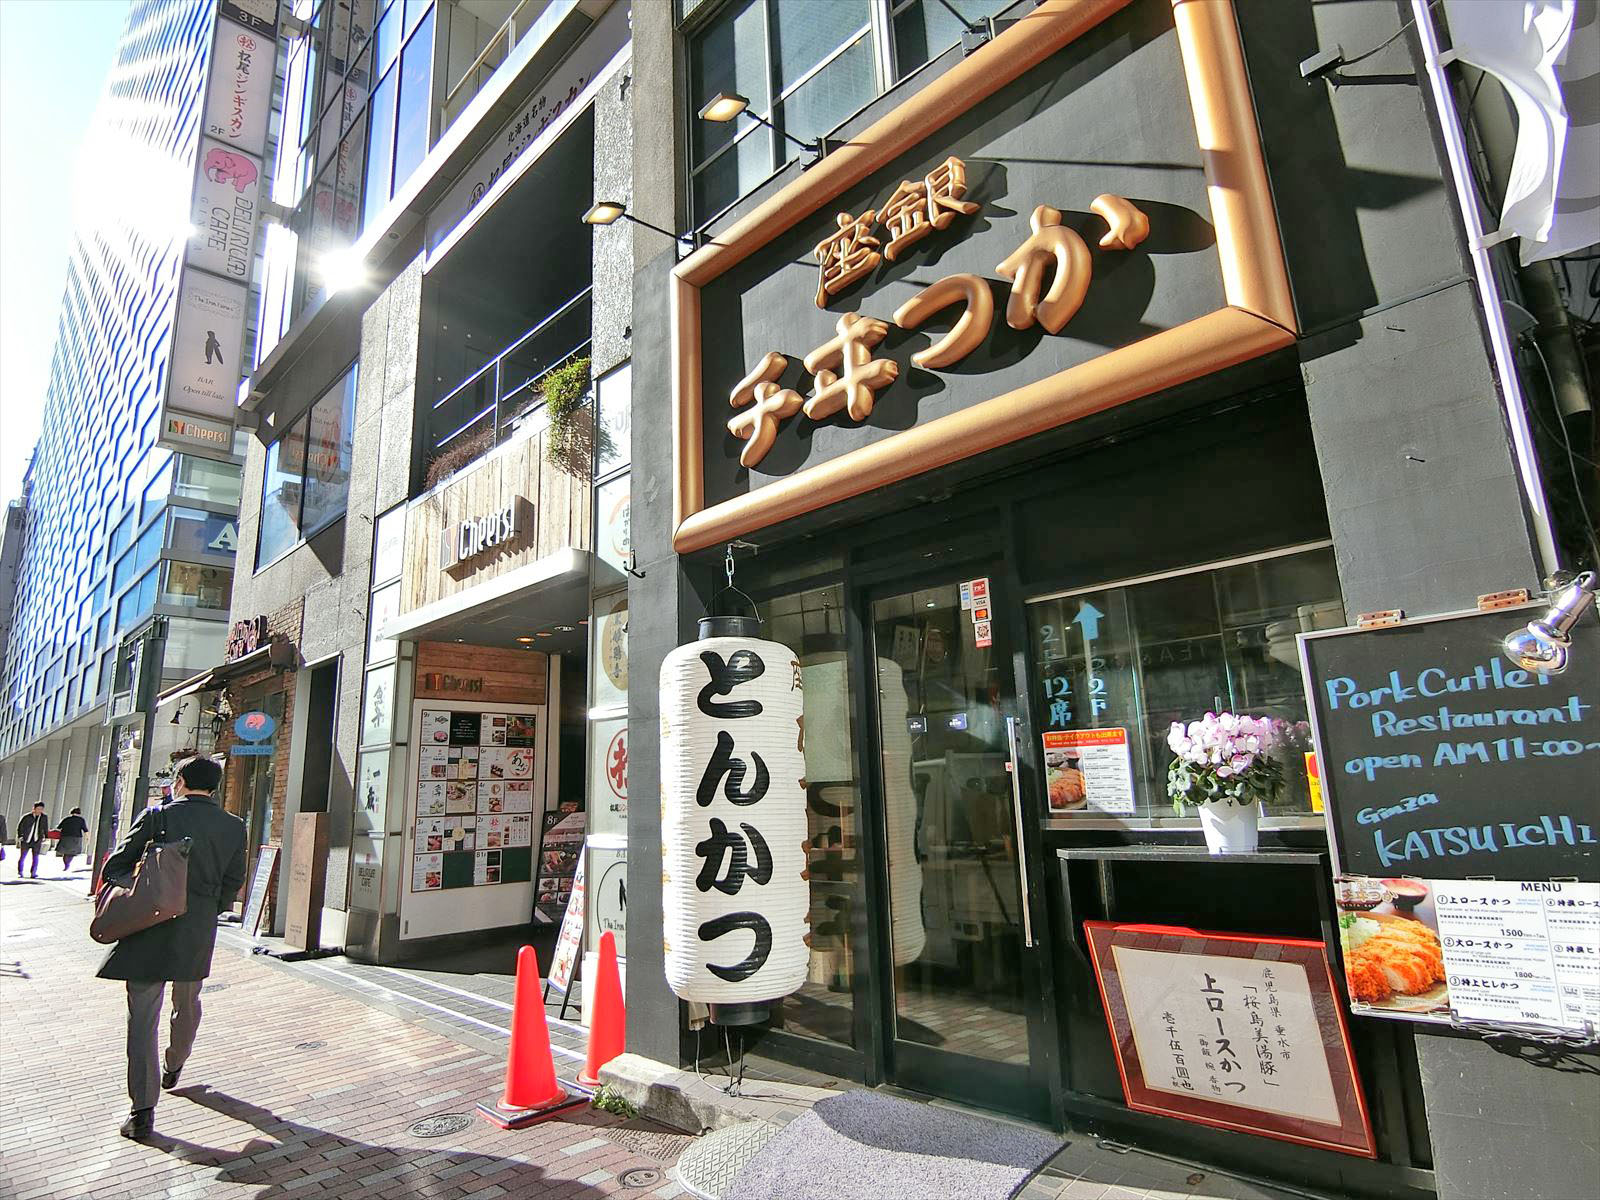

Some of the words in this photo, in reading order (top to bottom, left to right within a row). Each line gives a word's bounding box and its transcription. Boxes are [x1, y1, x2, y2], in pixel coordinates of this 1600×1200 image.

[239, 10, 262, 26] 3F
[229, 51, 252, 139] 松尾ジンギスカン
[211, 125, 225, 135] 2F
[207, 207, 231, 252] CAFE
[227, 196, 254, 276] DELIRIUM
[183, 385, 201, 396] Open
[211, 389, 225, 401] late
[197, 376, 215, 385] BAR
[185, 423, 227, 443] Cheers!
[208, 522, 238, 551] A
[458, 501, 515, 560] Cheers!
[1325, 670, 1417, 710] Pork
[1371, 696, 1592, 738] Restaurant
[1344, 753, 1422, 781] open
[547, 814, 558, 825] 8F
[696, 650, 773, 982] とんかつ
[1356, 791, 1439, 825] Ginza
[1521, 882, 1562, 893] MENU
[1500, 928, 1523, 937] 1500
[1514, 971, 1534, 979] 1800
[1520, 1011, 1540, 1019] 1900
[1200, 972, 1246, 1093] 上ロースかつ
[1275, 1024, 1291, 1061] 垂水市
